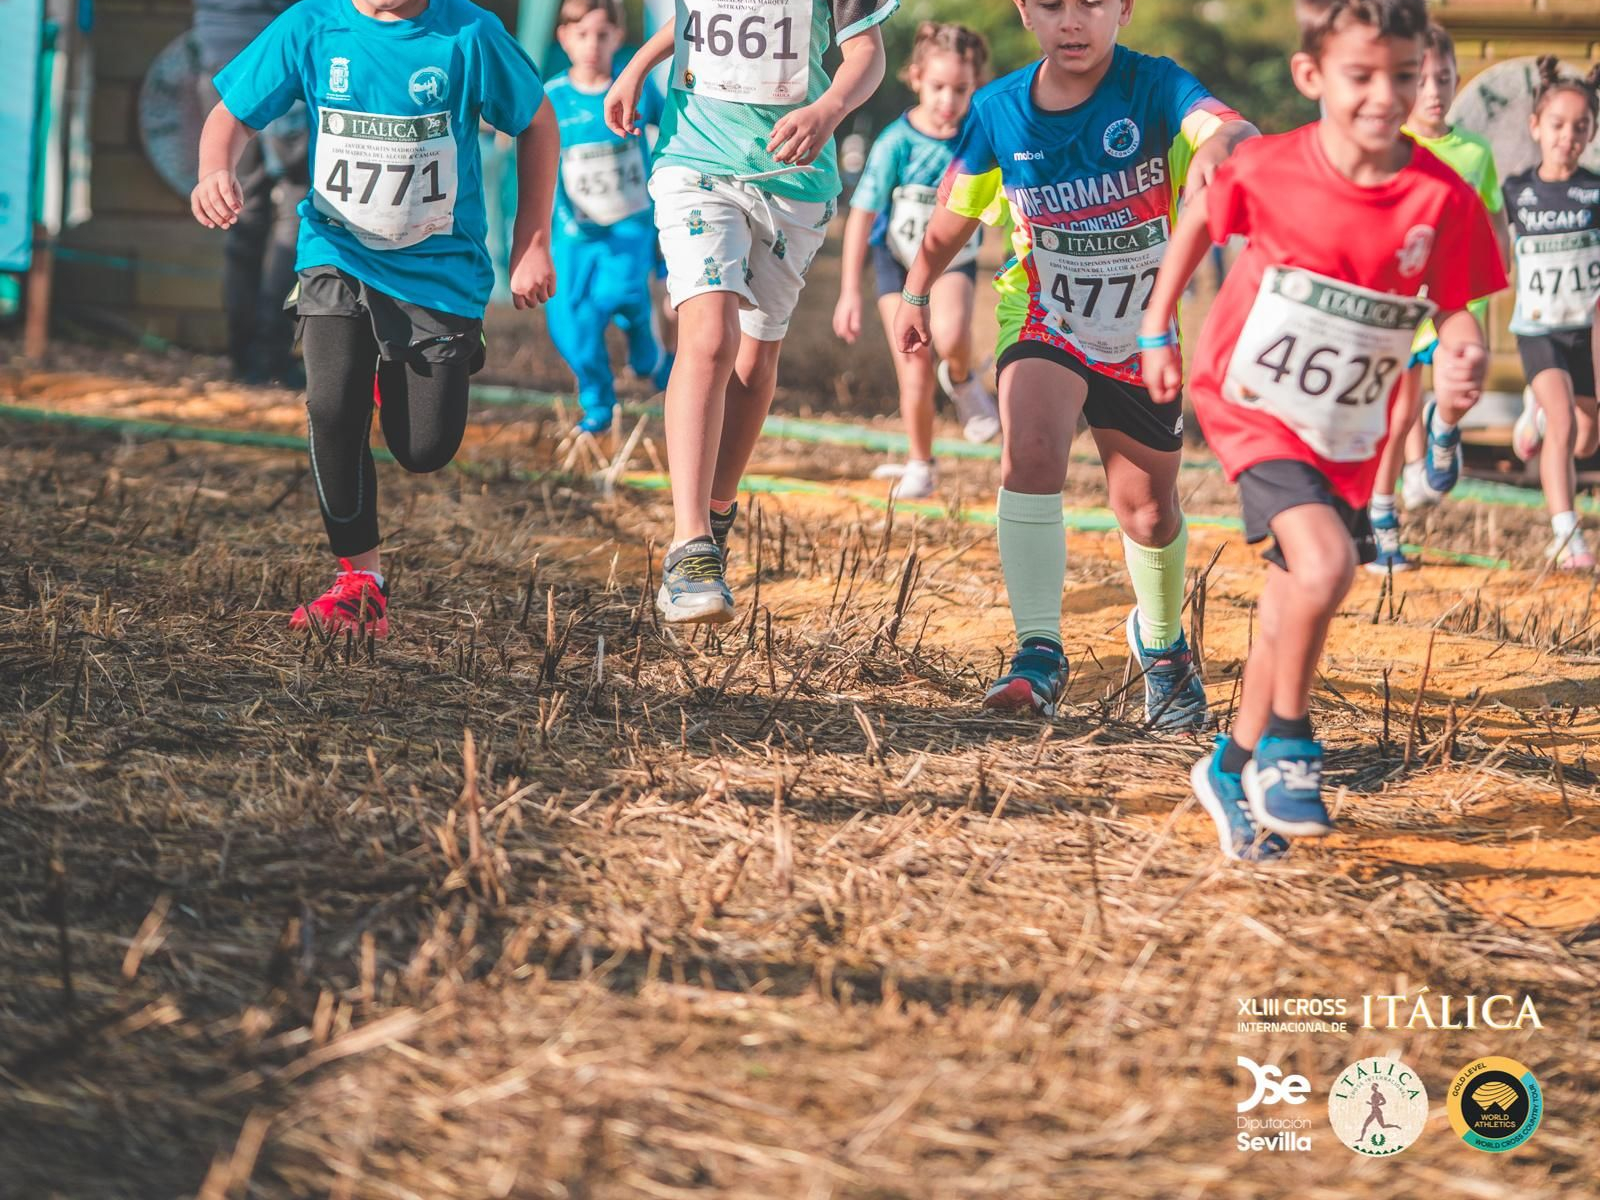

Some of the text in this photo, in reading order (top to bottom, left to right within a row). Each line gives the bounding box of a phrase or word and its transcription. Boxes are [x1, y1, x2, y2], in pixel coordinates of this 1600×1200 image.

[683, 9, 798, 60] 4661
[326, 159, 447, 206] 4771
[1015, 157, 1165, 217] INFORMALES
[1068, 235, 1139, 251] ITÁLICA
[1051, 268, 1159, 319] 4772
[1529, 261, 1600, 295] 4719
[1256, 334, 1398, 405] 4628
